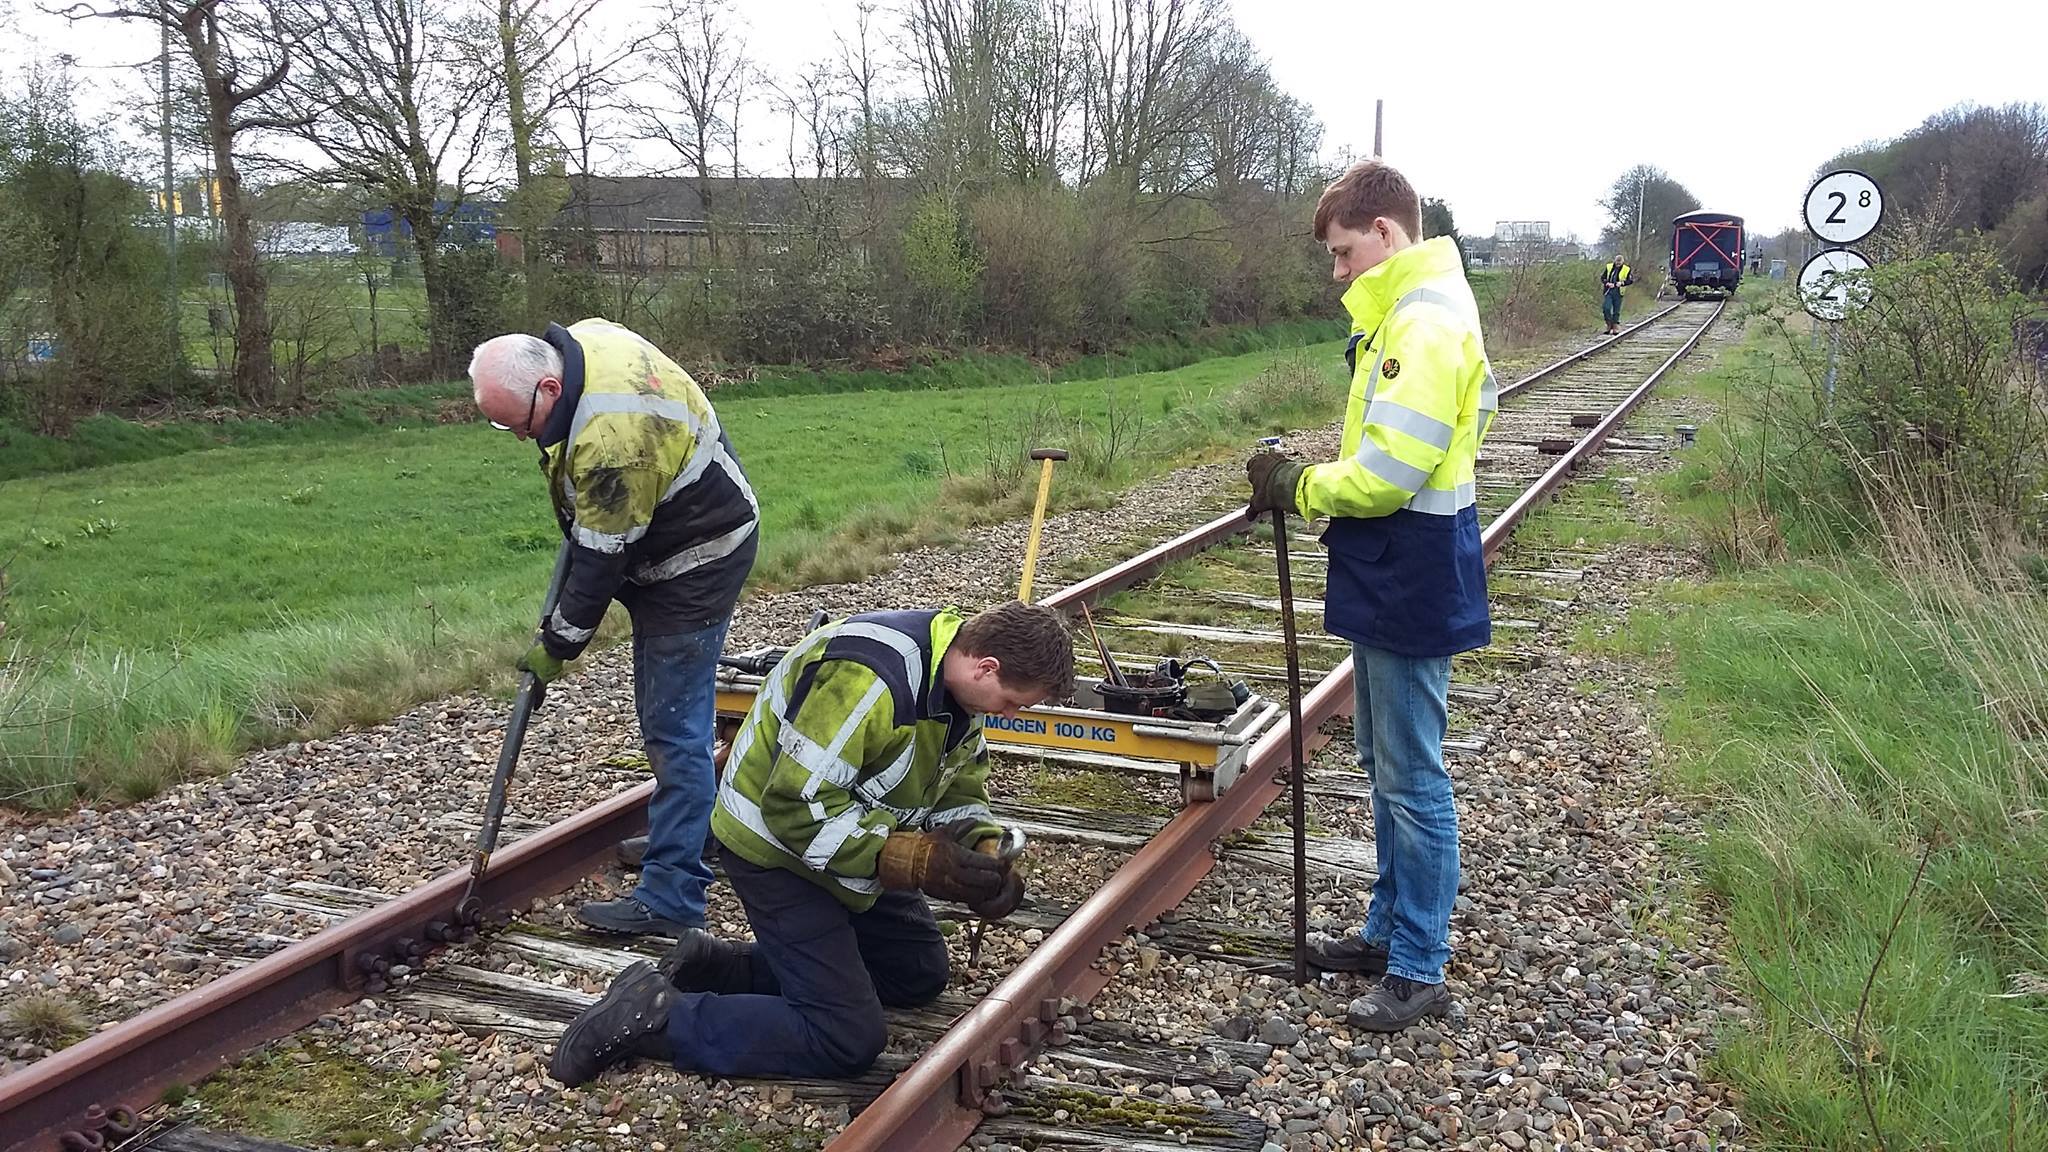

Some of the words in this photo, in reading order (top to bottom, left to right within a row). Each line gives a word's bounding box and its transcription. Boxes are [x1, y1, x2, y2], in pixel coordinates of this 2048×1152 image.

[1825, 192, 1847, 224] 2
[1858, 190, 1871, 208] 8
[1055, 722, 1084, 739] 100
[1091, 726, 1116, 742] KG
